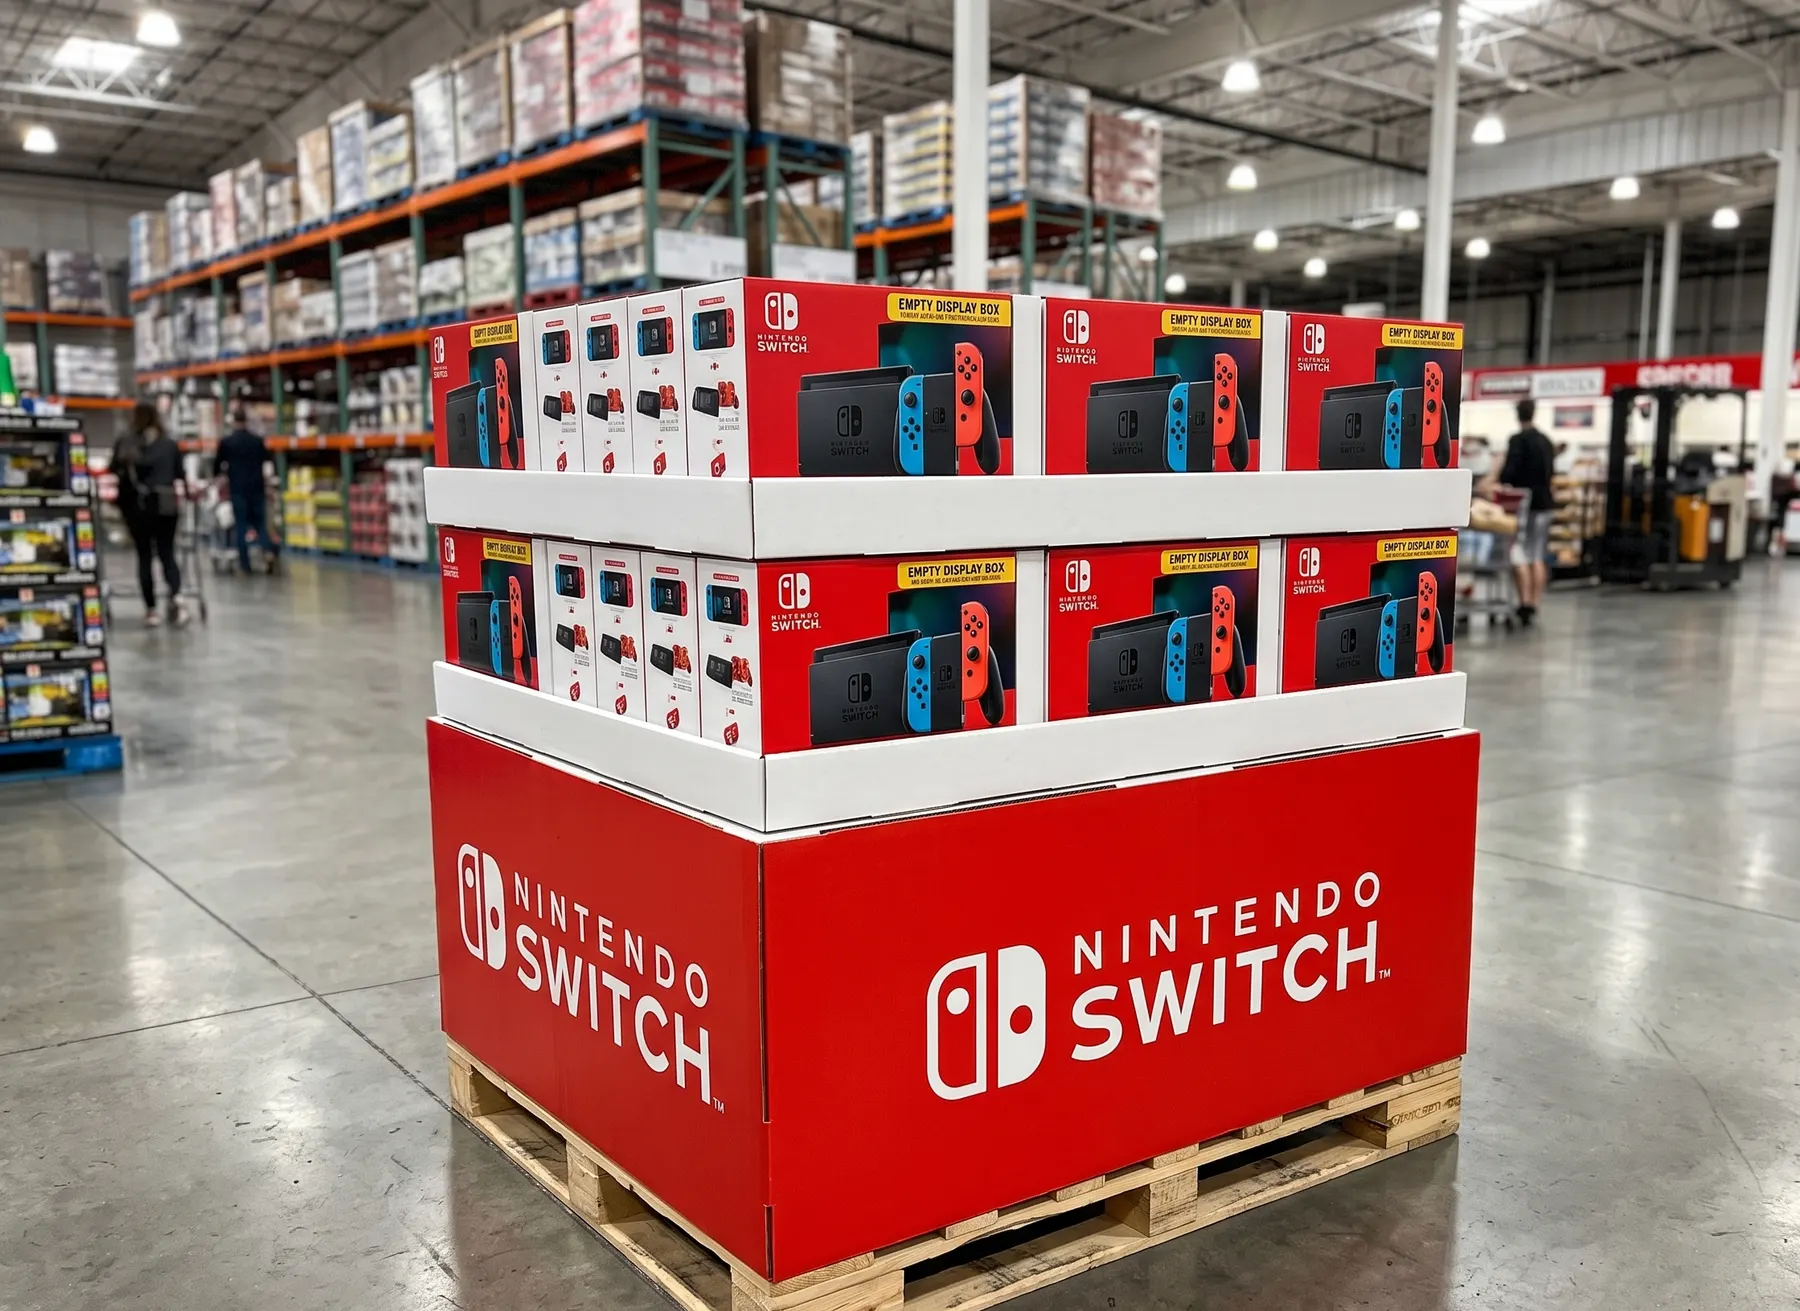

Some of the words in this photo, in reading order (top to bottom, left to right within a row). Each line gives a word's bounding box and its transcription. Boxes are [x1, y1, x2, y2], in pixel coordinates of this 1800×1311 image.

[898, 297, 933, 312] EMPTY
[936, 300, 977, 314] DISPLAY
[980, 303, 1000, 316] BOX
[1170, 313, 1198, 326] EMPTY
[1200, 316, 1234, 328] DISPLAY
[1235, 318, 1252, 329] BOX
[1389, 327, 1412, 338] EMPTY
[1413, 329, 1441, 340] DISPLAY
[1442, 331, 1456, 341] BOX
[757, 341, 807, 353] SWITCH
[1056, 353, 1096, 365] SWITCH
[830, 446, 869, 456] SWITCH
[1384, 542, 1407, 552] EMPTY
[1408, 540, 1435, 551] DISPLAY
[1435, 539, 1450, 549] BOX
[1169, 552, 1197, 564] EMPTY
[1198, 551, 1231, 562] DISPLAY
[1233, 550, 1249, 560] BOX
[908, 565, 941, 578] EMPTY
[943, 563, 983, 576] DISPLAY
[985, 562, 1005, 573] BOX
[1059, 601, 1097, 612] SWITCH
[771, 612, 819, 620] NINTENDO
[771, 619, 819, 632] SWITCH
[1073, 871, 1381, 974] NINTENDO
[514, 871, 709, 1008] NINTENDO
[1071, 919, 1378, 1061] SWITCH
[515, 923, 711, 1105] SWITCH
